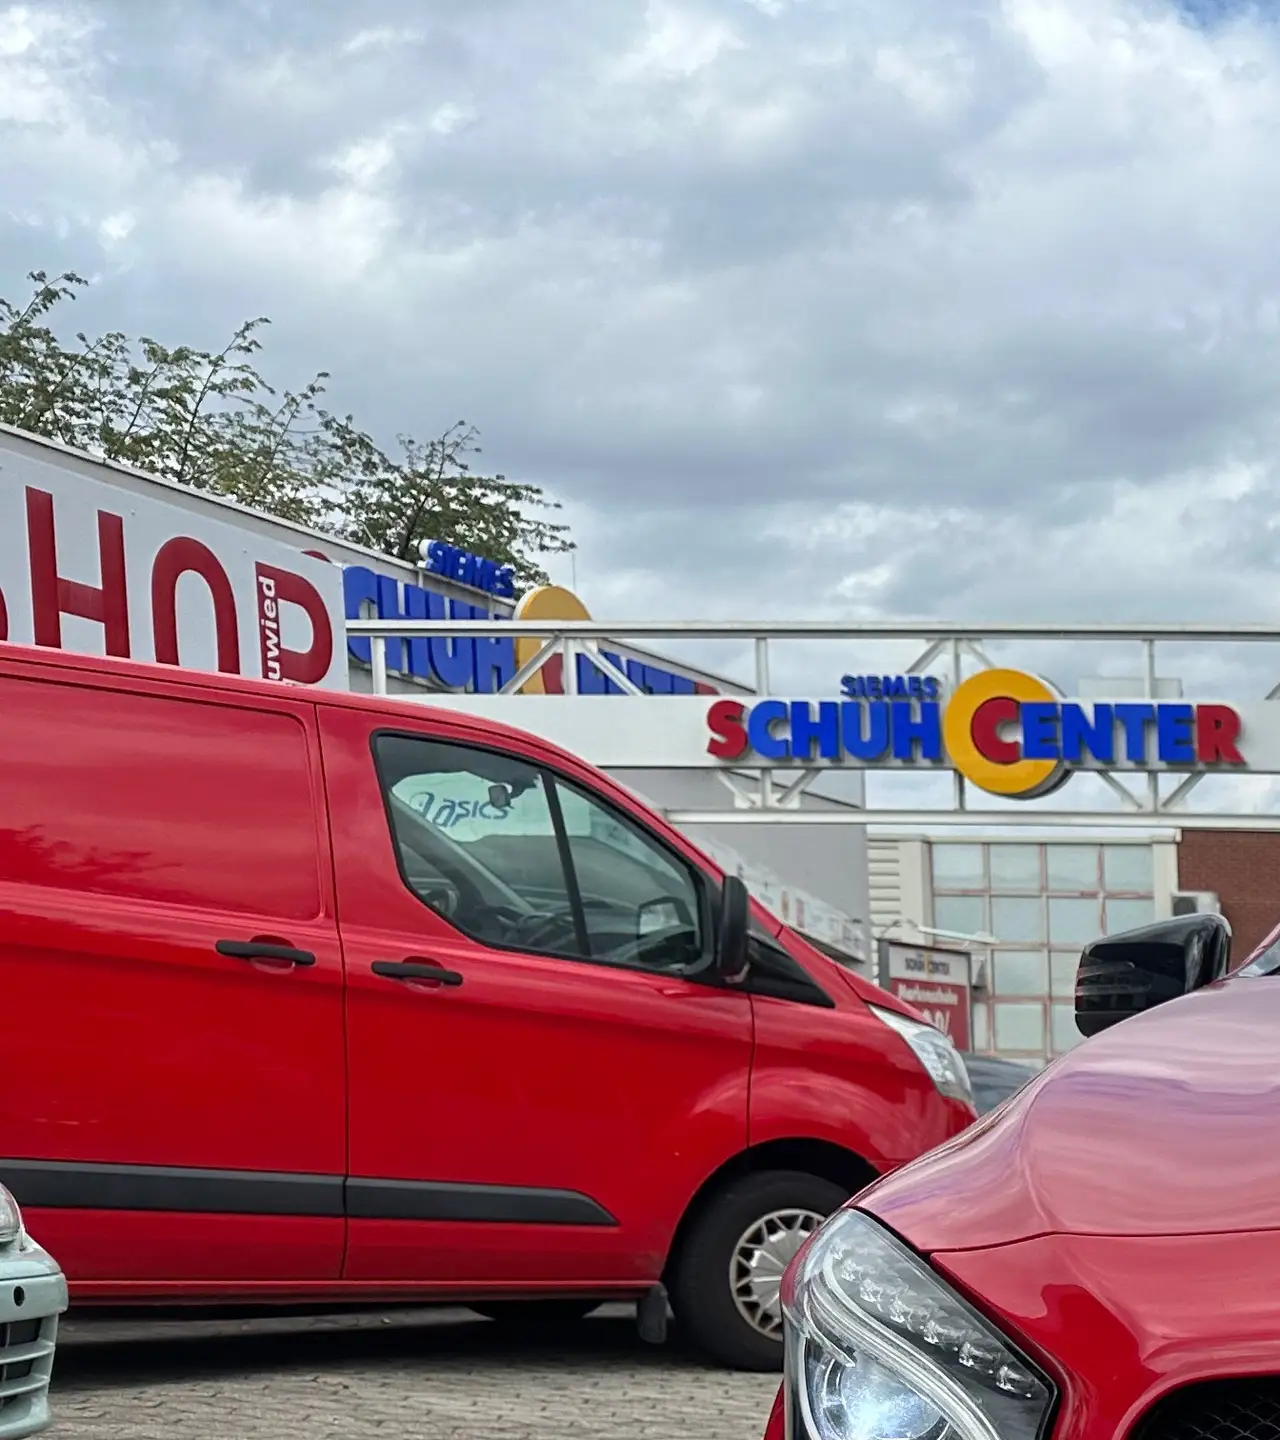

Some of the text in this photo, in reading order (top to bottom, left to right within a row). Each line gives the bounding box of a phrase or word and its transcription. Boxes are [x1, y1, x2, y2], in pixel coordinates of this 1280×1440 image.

[0, 485, 333, 684] HOP
[258, 576, 281, 680] uwied
[301, 551, 516, 695] CHUH
[707, 696, 1245, 766] SCHUH CENTER
[841, 674, 938, 699] SIEMES
